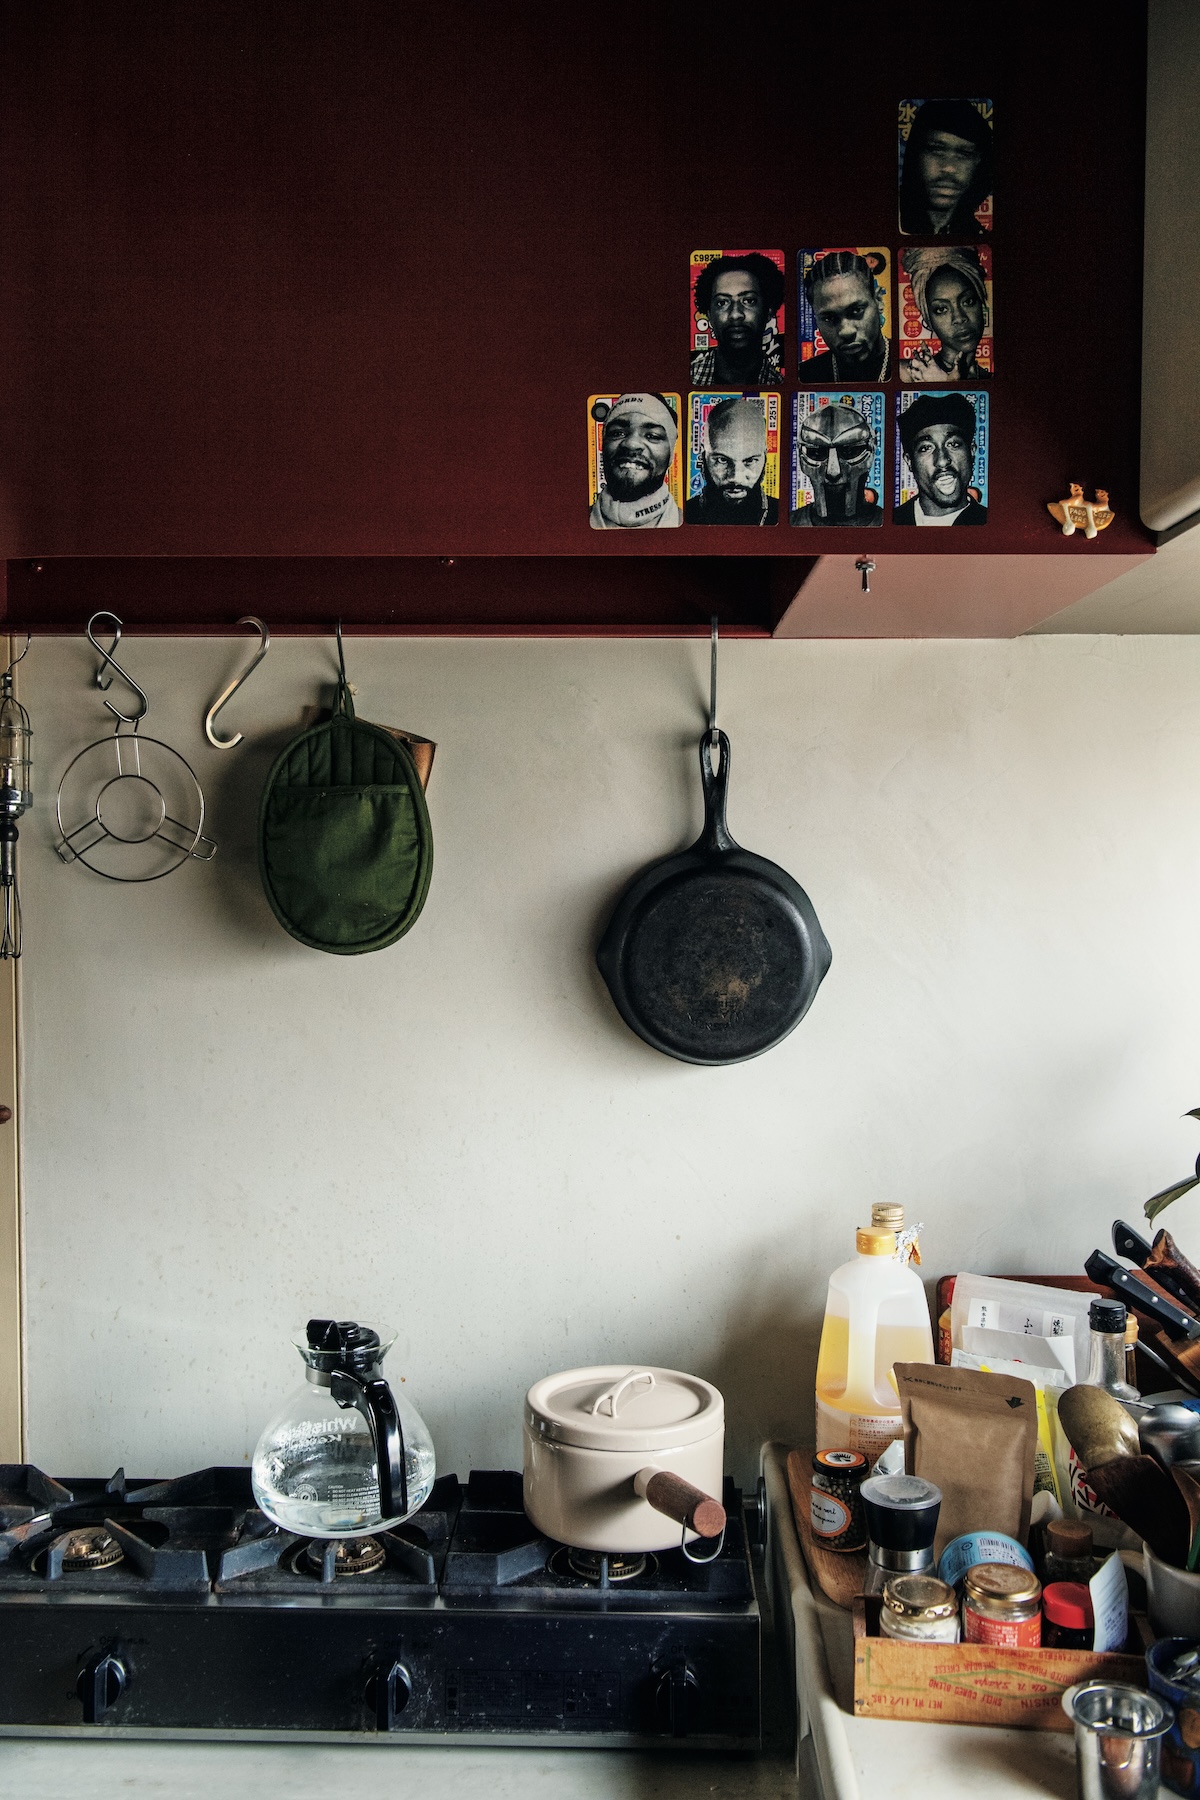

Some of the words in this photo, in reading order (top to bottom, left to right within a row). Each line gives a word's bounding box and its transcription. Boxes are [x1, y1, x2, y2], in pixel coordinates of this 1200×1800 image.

[635, 502, 662, 518] STRESS
[671, 1646, 689, 1654] OFF
[930, 1700, 942, 1709] NET
